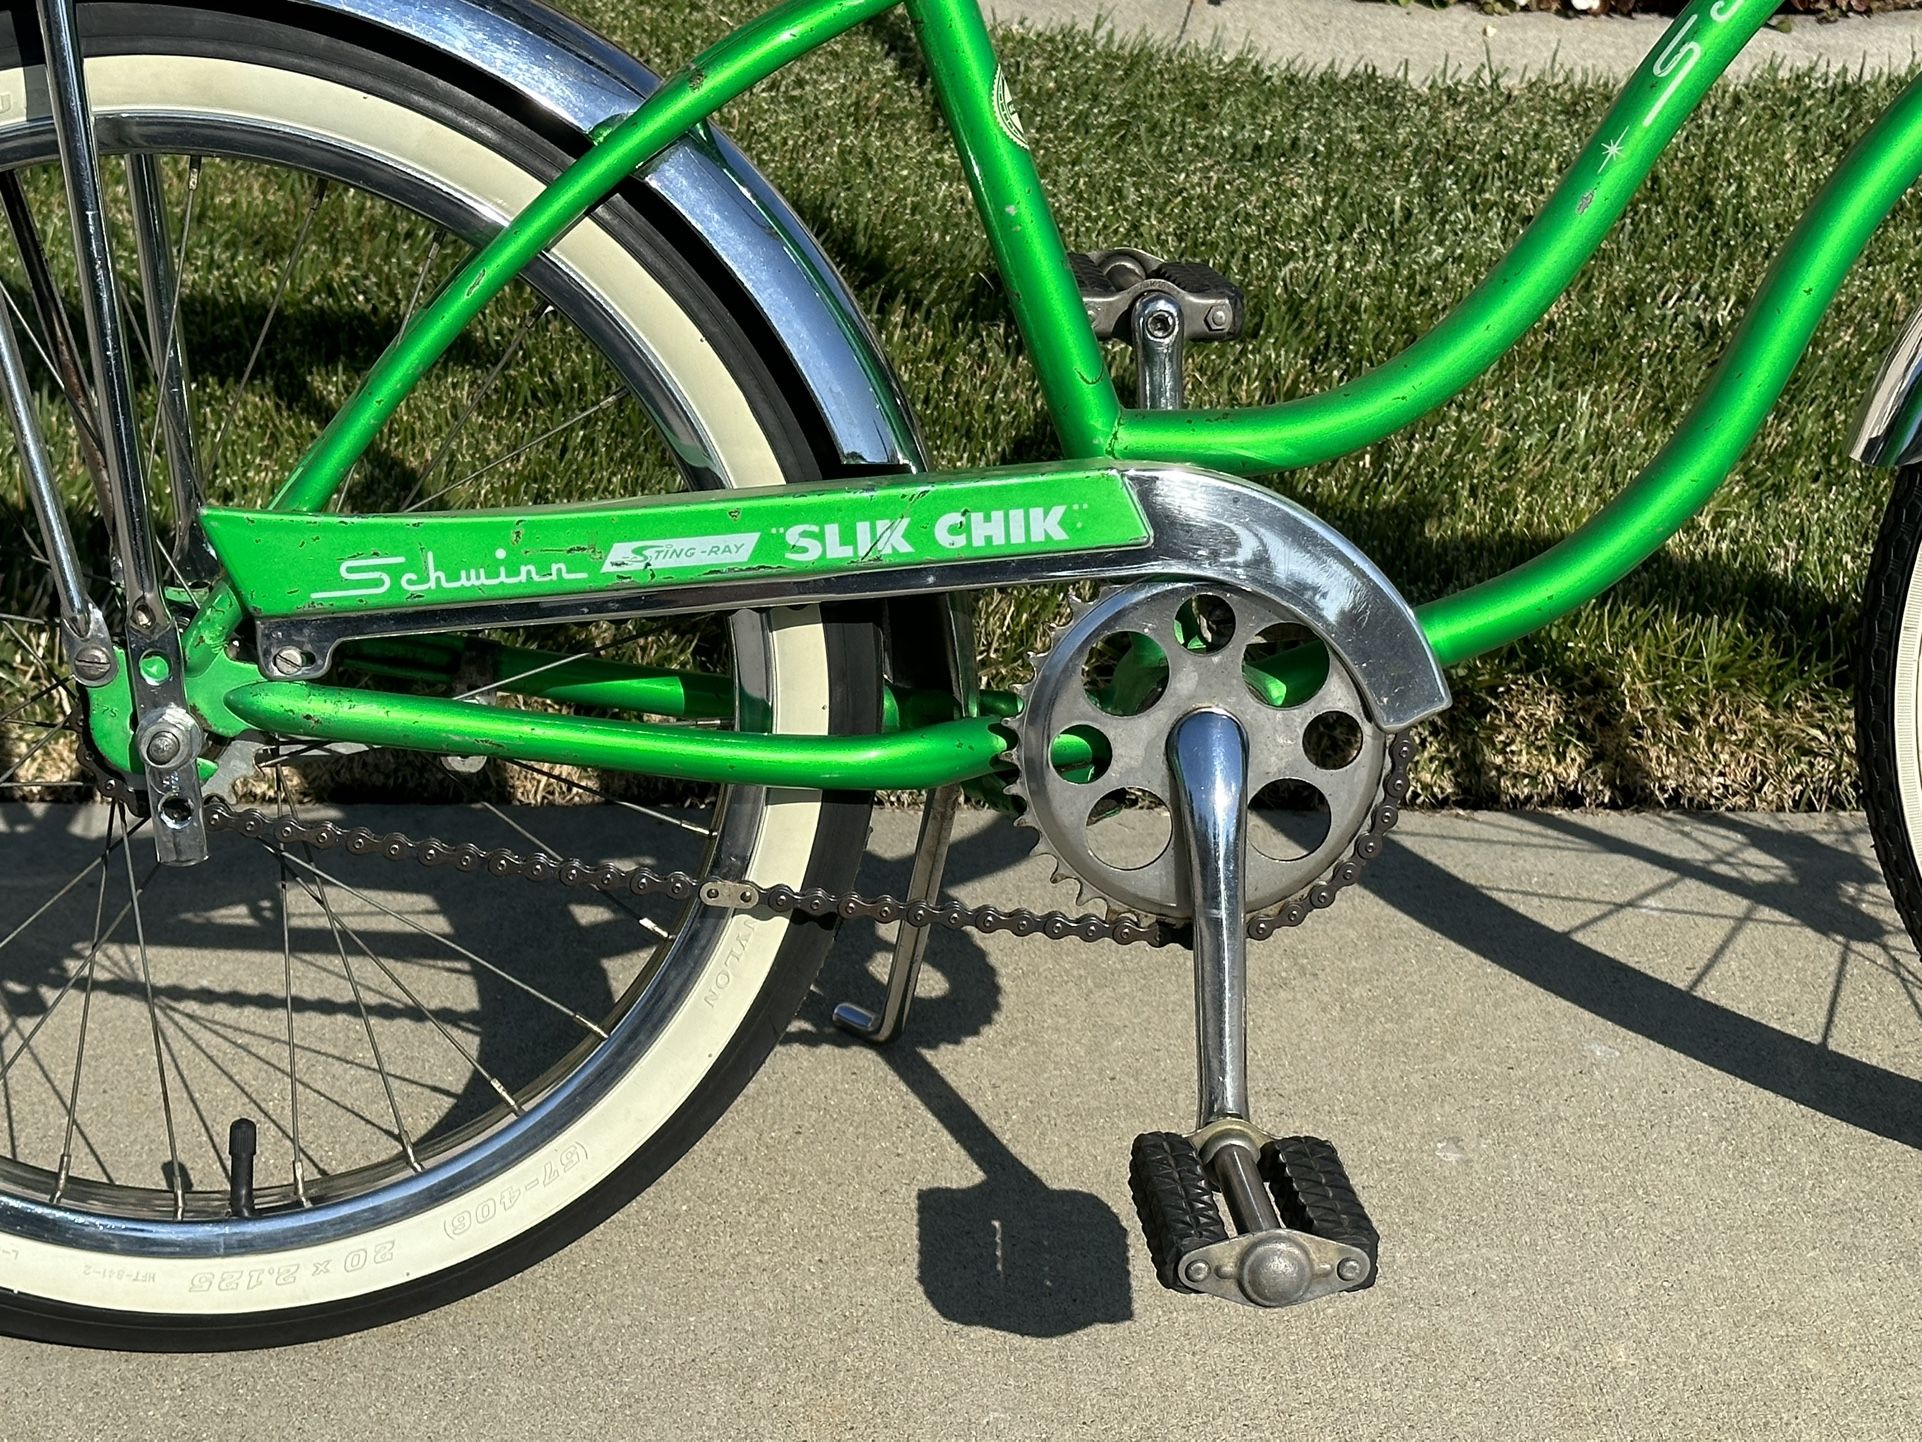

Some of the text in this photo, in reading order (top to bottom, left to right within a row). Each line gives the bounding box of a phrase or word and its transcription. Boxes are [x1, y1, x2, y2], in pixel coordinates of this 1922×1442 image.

[310, 548, 589, 599] Schwinn
[444, 1141, 589, 1241] (57-406)
[189, 1264, 299, 1293] 2.125
[343, 1239, 396, 1275] 20
